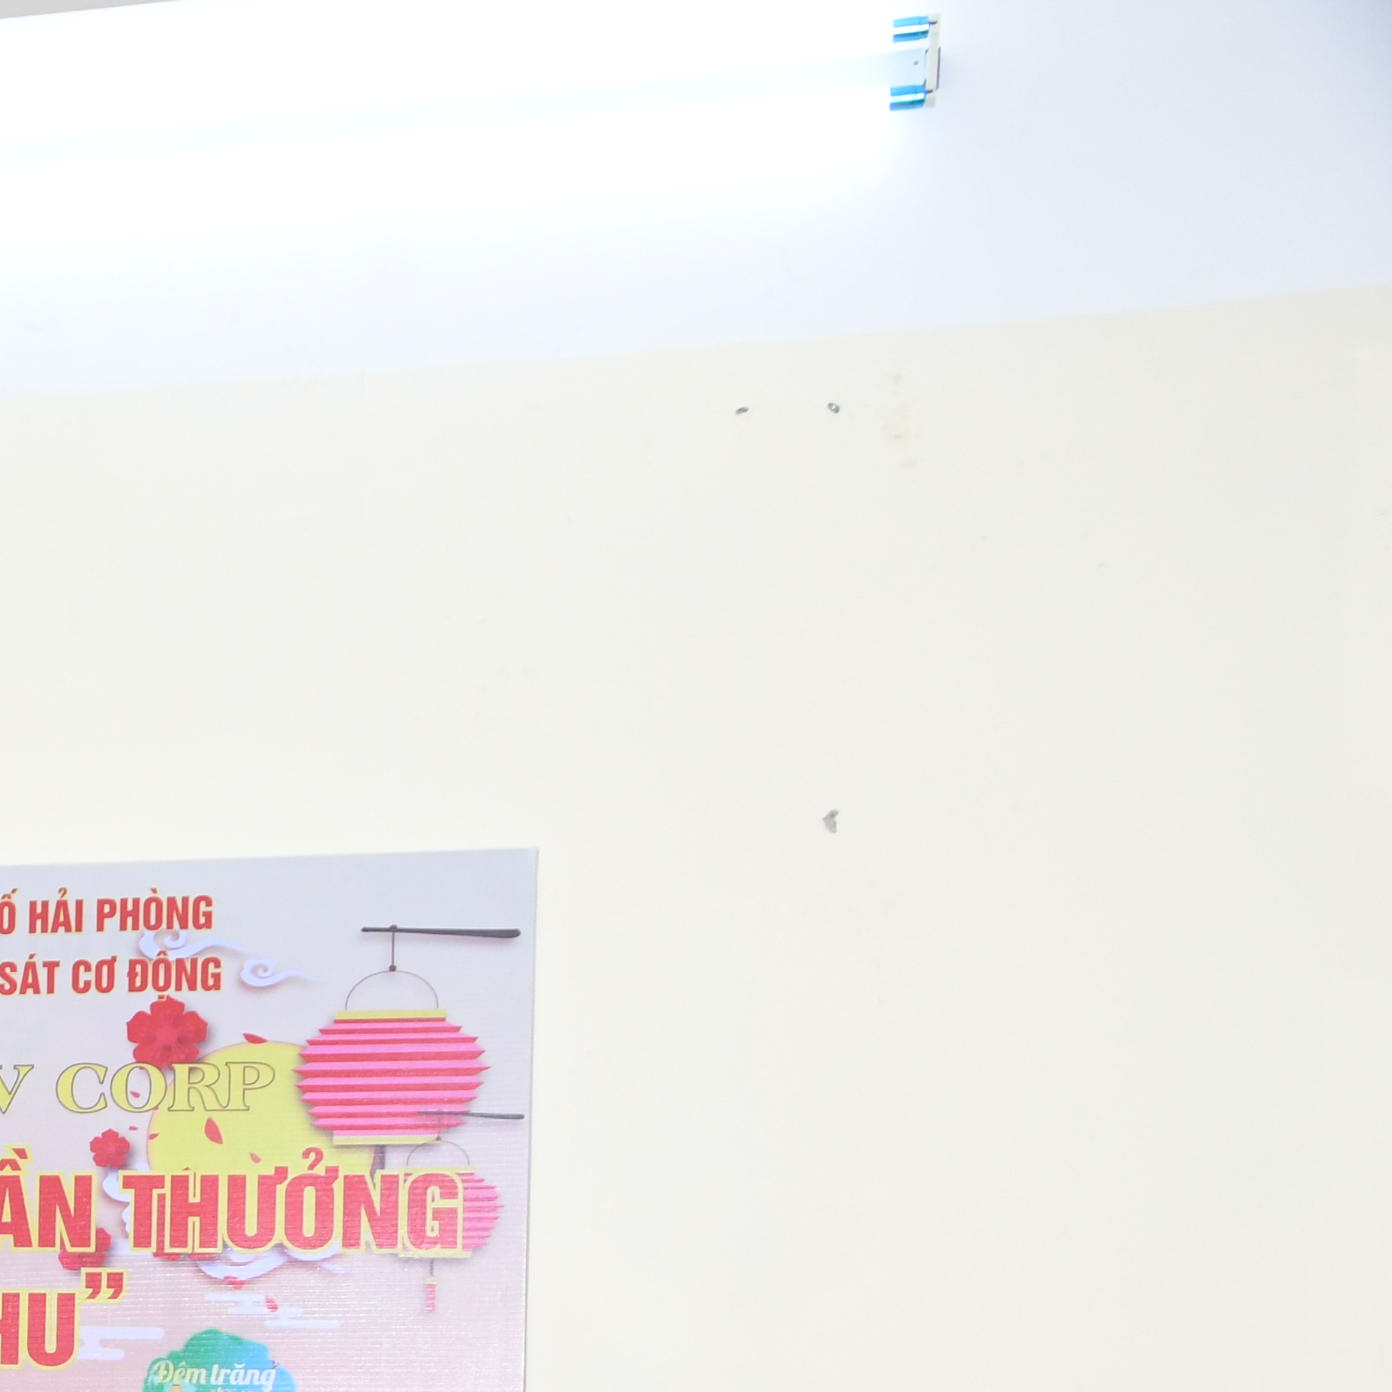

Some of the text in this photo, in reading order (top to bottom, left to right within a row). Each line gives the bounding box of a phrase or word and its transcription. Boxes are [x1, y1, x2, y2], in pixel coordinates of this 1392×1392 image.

[28, 887, 83, 934] HẢI
[96, 887, 213, 932] PHÒNG
[71, 955, 117, 994] CƠ
[127, 951, 222, 1000] ĐỘNG
[56, 1061, 275, 1113] CORP
[120, 1147, 461, 1253] THƯỞNG
